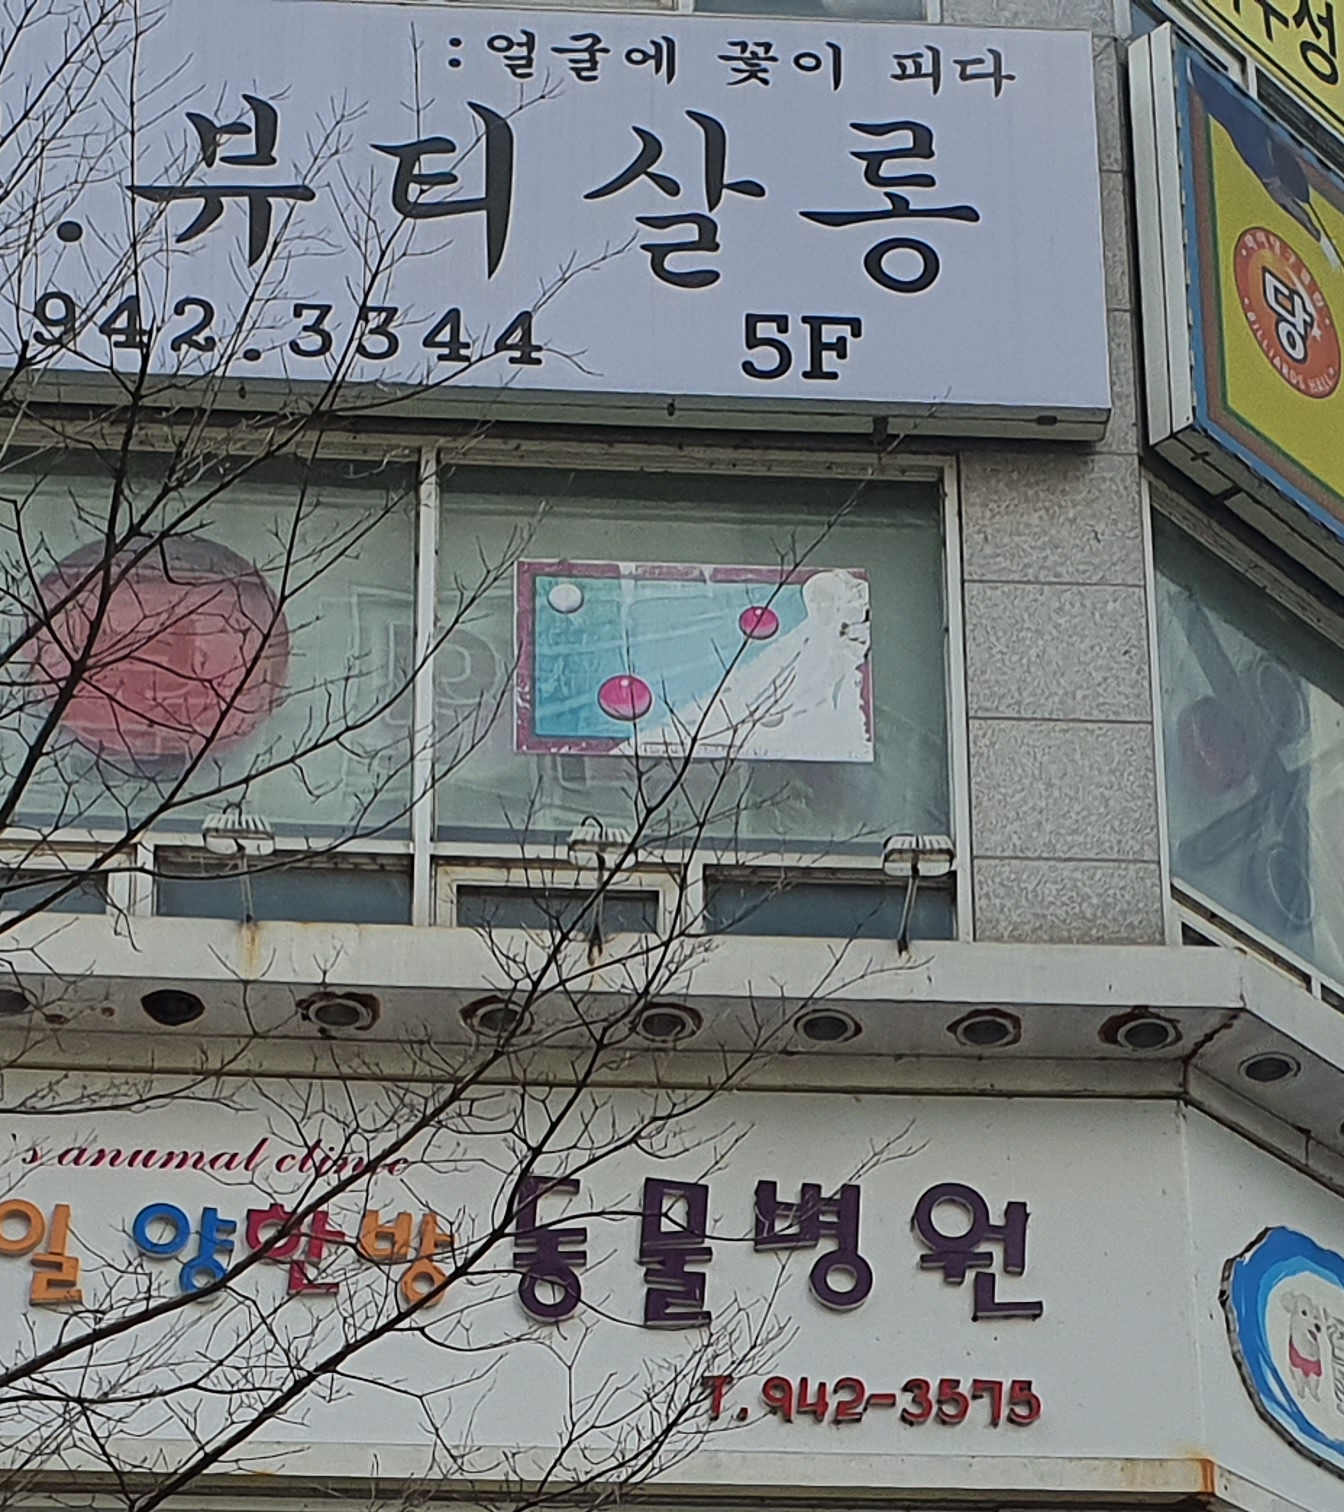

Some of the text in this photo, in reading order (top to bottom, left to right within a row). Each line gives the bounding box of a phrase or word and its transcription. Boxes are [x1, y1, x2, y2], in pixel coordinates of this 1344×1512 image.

[716, 38, 844, 92] 꽃이
[889, 43, 1016, 98] 피다
[739, 312, 864, 382] 5F
[274, 1139, 410, 1178] clinc
[131, 1202, 457, 1309] 양한방
[512, 1174, 1044, 1330] 동물병원
[700, 1373, 1044, 1427] T.942-3575
